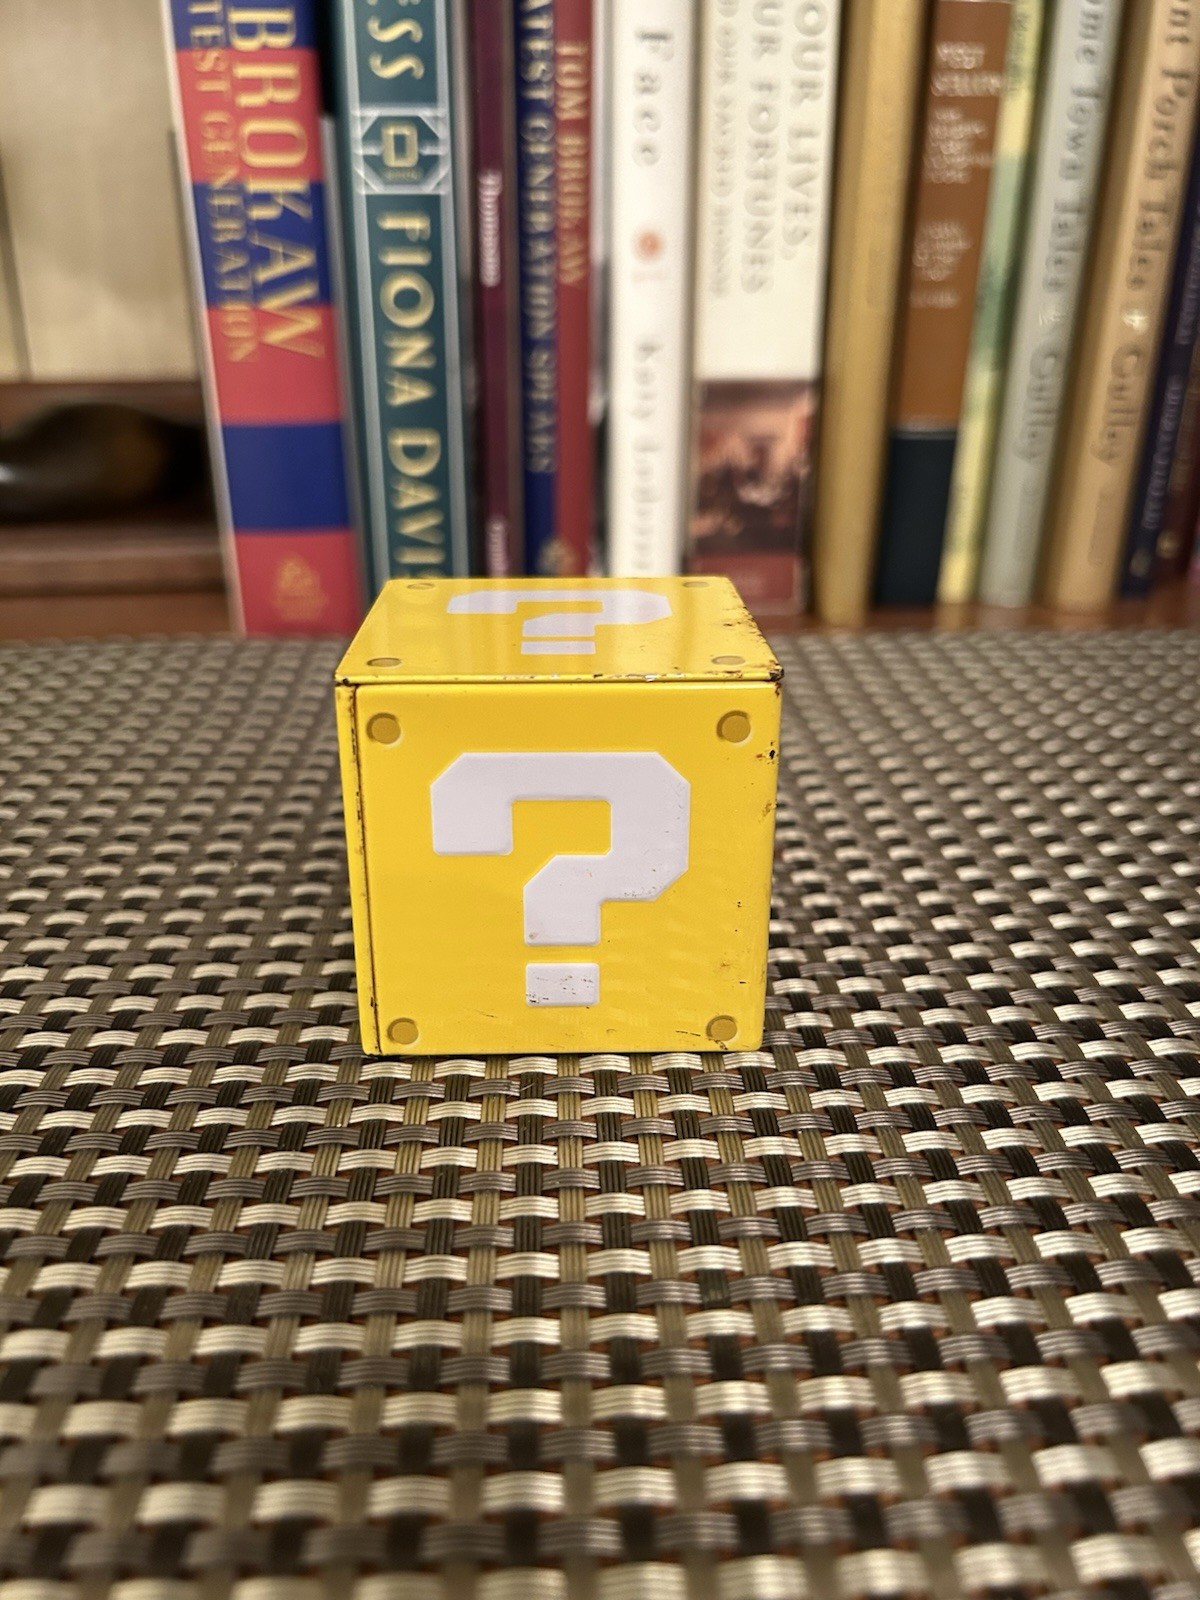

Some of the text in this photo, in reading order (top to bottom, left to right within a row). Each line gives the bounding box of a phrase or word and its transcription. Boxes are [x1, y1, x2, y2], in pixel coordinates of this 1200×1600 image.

[366, 0, 425, 80] SS
[632, 25, 675, 168] Face
[779, 0, 829, 261] OUR LIVES,
[1042, 0, 1110, 291] me Town Tales
[1144, 66, 1194, 180] Porch
[202, 110, 258, 362] GENERATION
[227, 6, 325, 358] BROKAW
[520, 113, 559, 338] GENERATION
[553, 40, 592, 287] TOM BROKAW
[741, 78, 781, 294] FORTUNES
[1126, 199, 1178, 291] Tales
[377, 210, 437, 407] FIONA
[388, 426, 447, 579] DAVI
